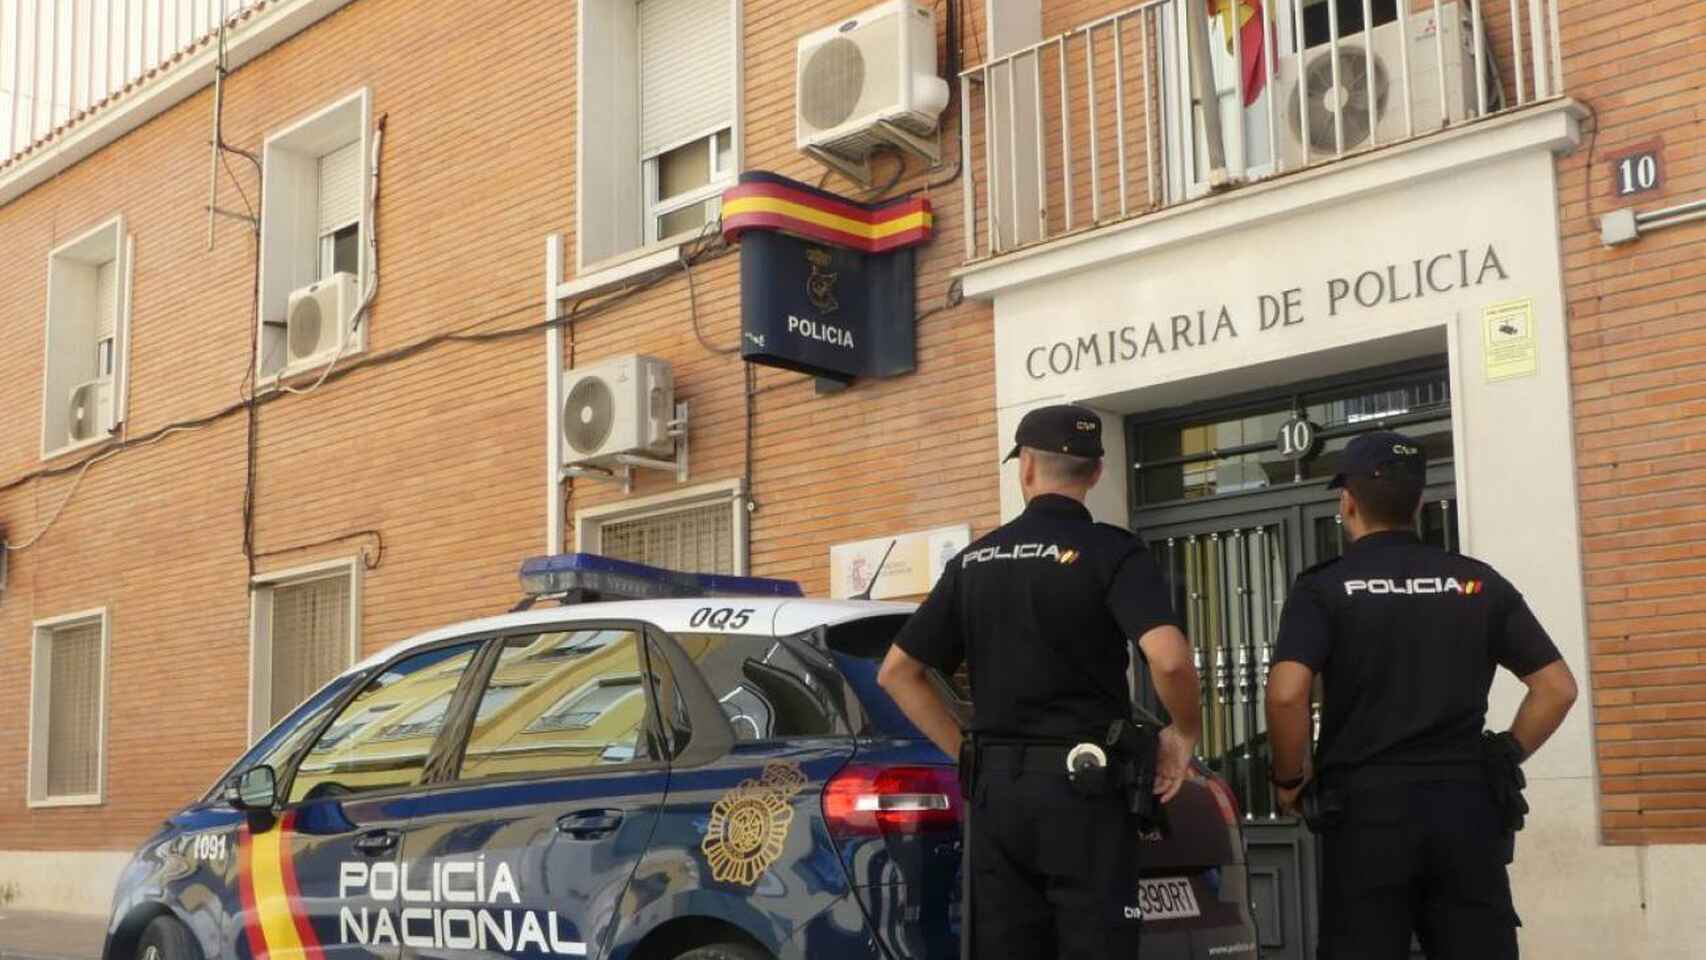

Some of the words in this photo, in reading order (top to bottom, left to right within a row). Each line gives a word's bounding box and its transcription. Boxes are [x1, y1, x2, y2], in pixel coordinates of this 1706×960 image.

[1619, 155, 1656, 194] 10
[1026, 304, 1238, 380] COMISARIA
[1258, 287, 1305, 332] DE
[1327, 243, 1510, 317] POLICIA
[787, 315, 855, 349] POLICIA
[1281, 421, 1309, 455] 10
[962, 544, 1061, 568] POLICIA
[1343, 577, 1464, 595] POLICIA
[193, 834, 227, 861] 1091
[339, 855, 521, 904] POLICÍA
[340, 907, 587, 956] NACIONAL
